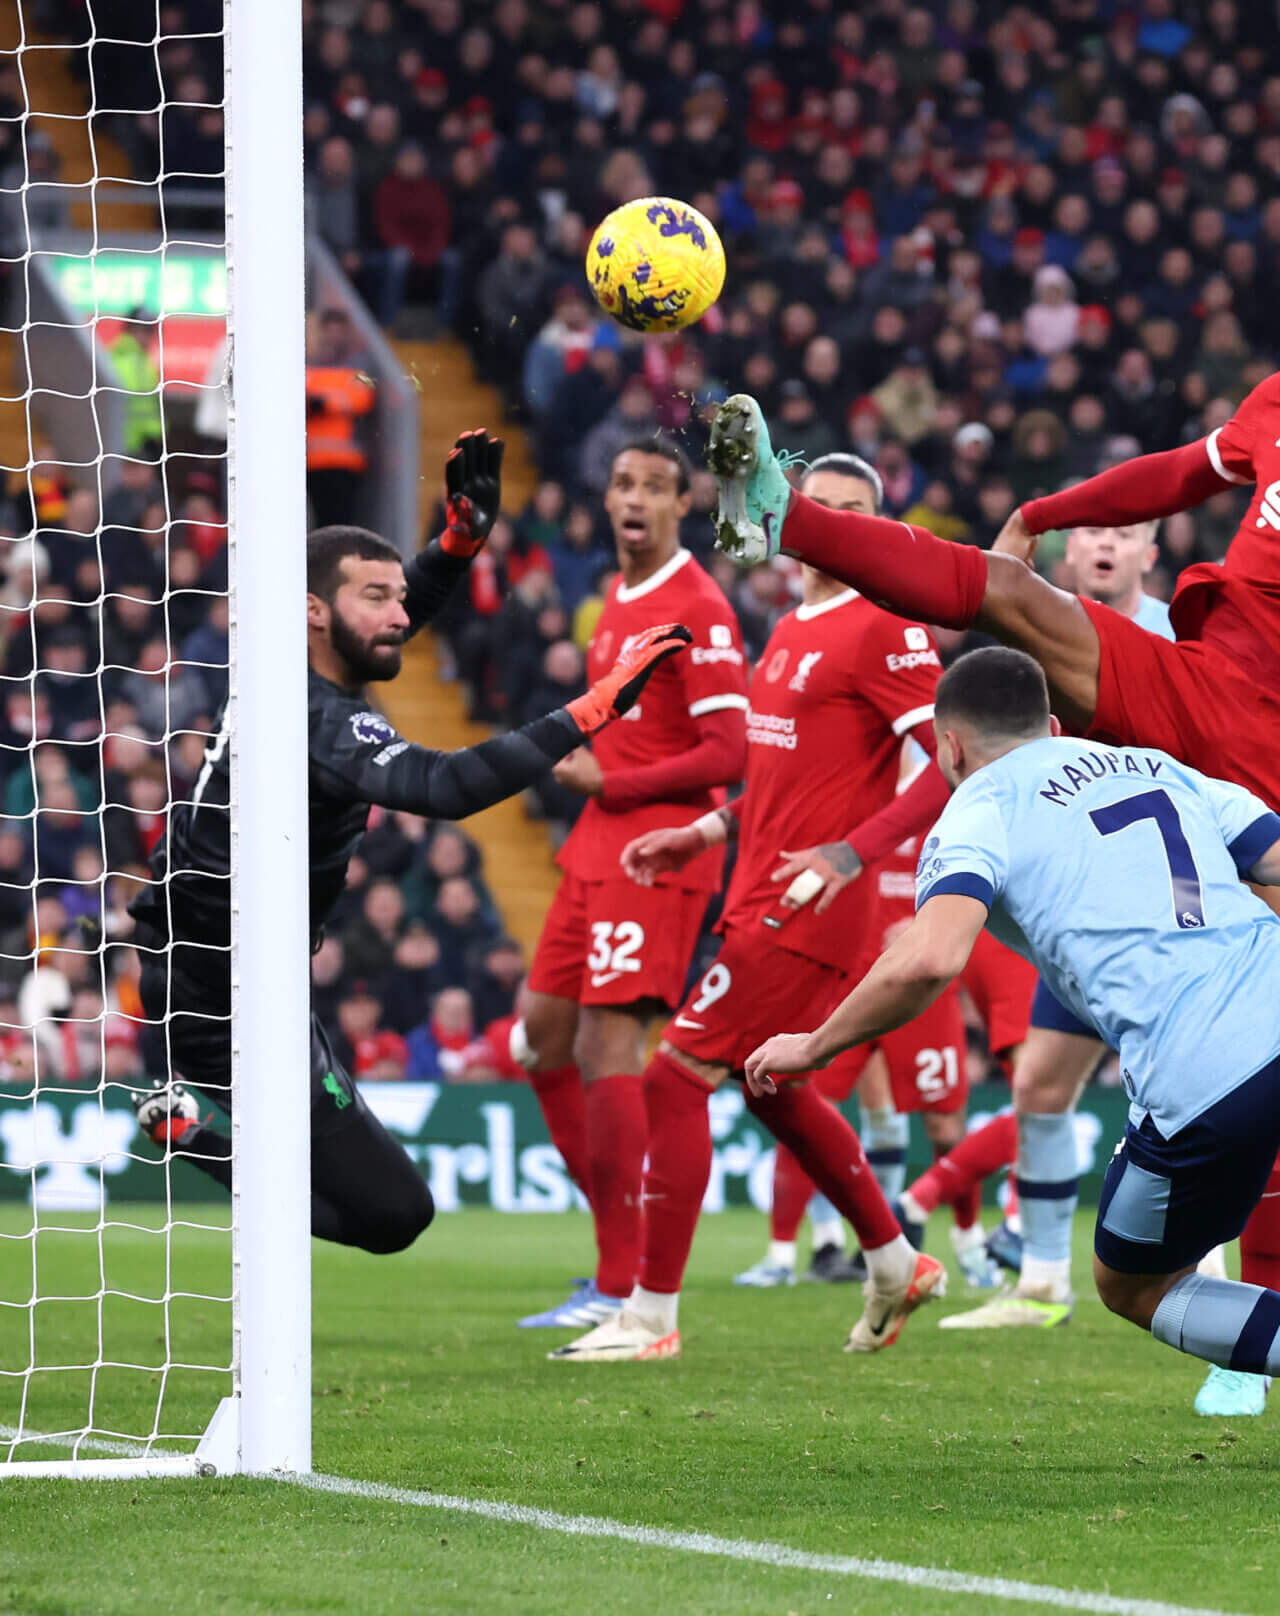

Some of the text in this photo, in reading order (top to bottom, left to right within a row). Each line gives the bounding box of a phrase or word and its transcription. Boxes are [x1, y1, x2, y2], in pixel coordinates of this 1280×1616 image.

[1088, 788, 1206, 929] 7
[588, 921, 645, 972] 32
[692, 963, 732, 1013] 9
[915, 1047, 959, 1091] 21
